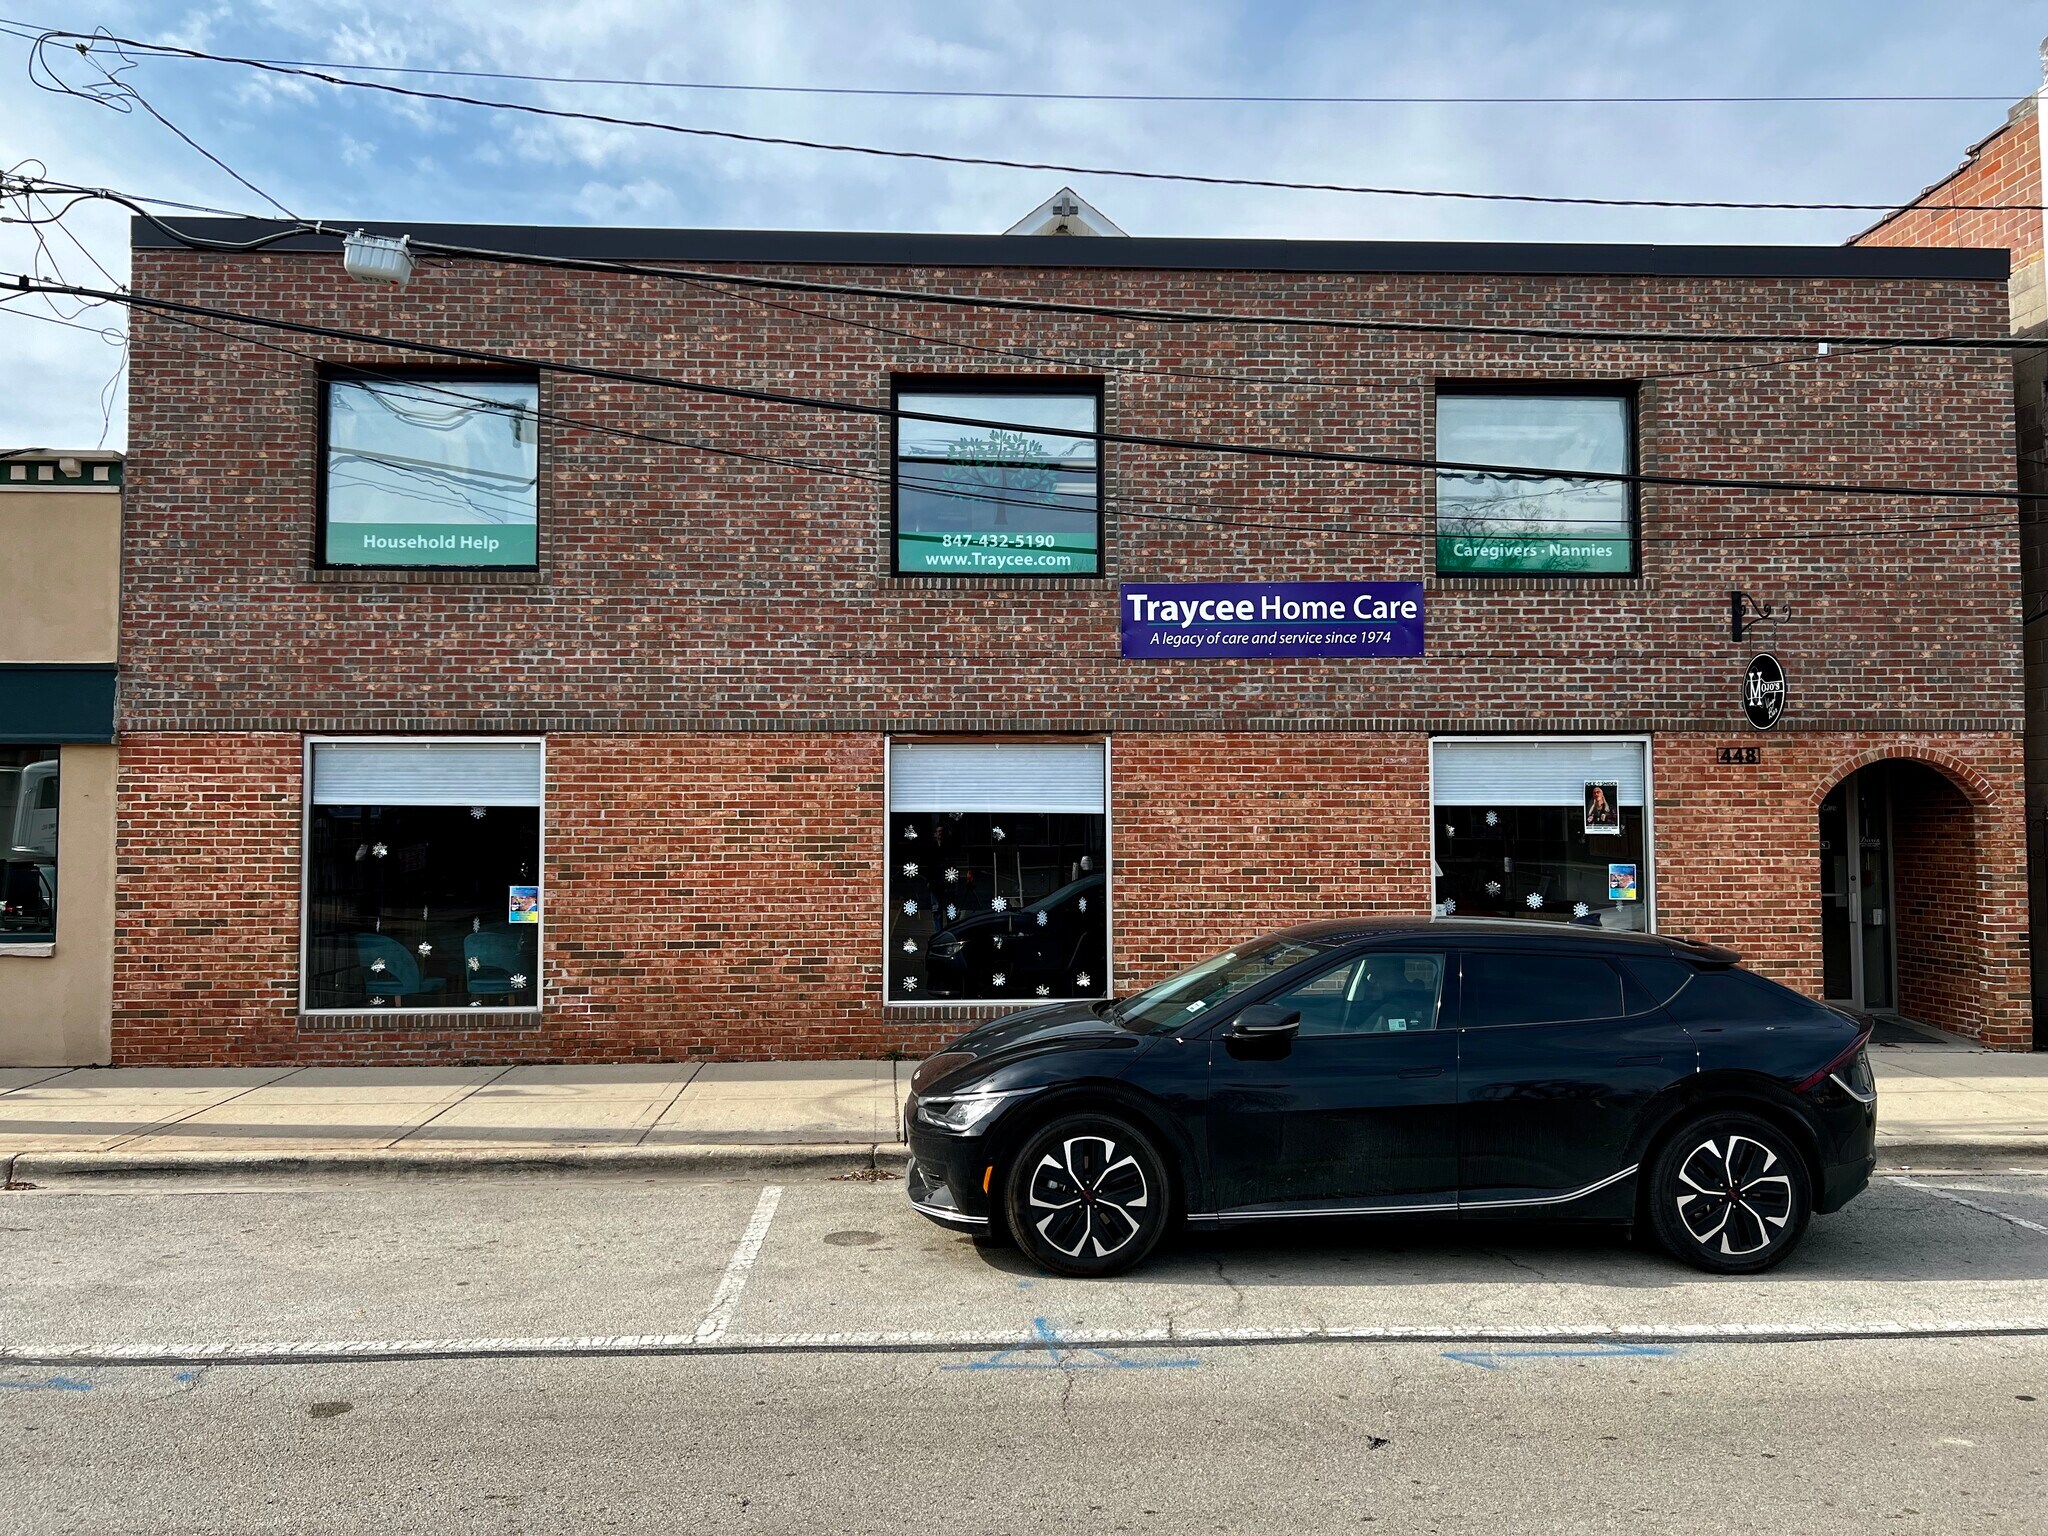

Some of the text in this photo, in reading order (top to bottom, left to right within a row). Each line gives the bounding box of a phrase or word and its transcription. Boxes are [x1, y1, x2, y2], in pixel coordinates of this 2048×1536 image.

[363, 534, 500, 552] Household Help
[942, 534, 1055, 548] 847-432-5190
[1453, 543, 1613, 560] Caregivers Nannies
[925, 552, 1071, 569] www.Traycee.com
[1126, 593, 1417, 628] Traycee Home Care
[1150, 631, 1391, 648] A legacy of care and service since 1974
[1720, 747, 1756, 763] 448
